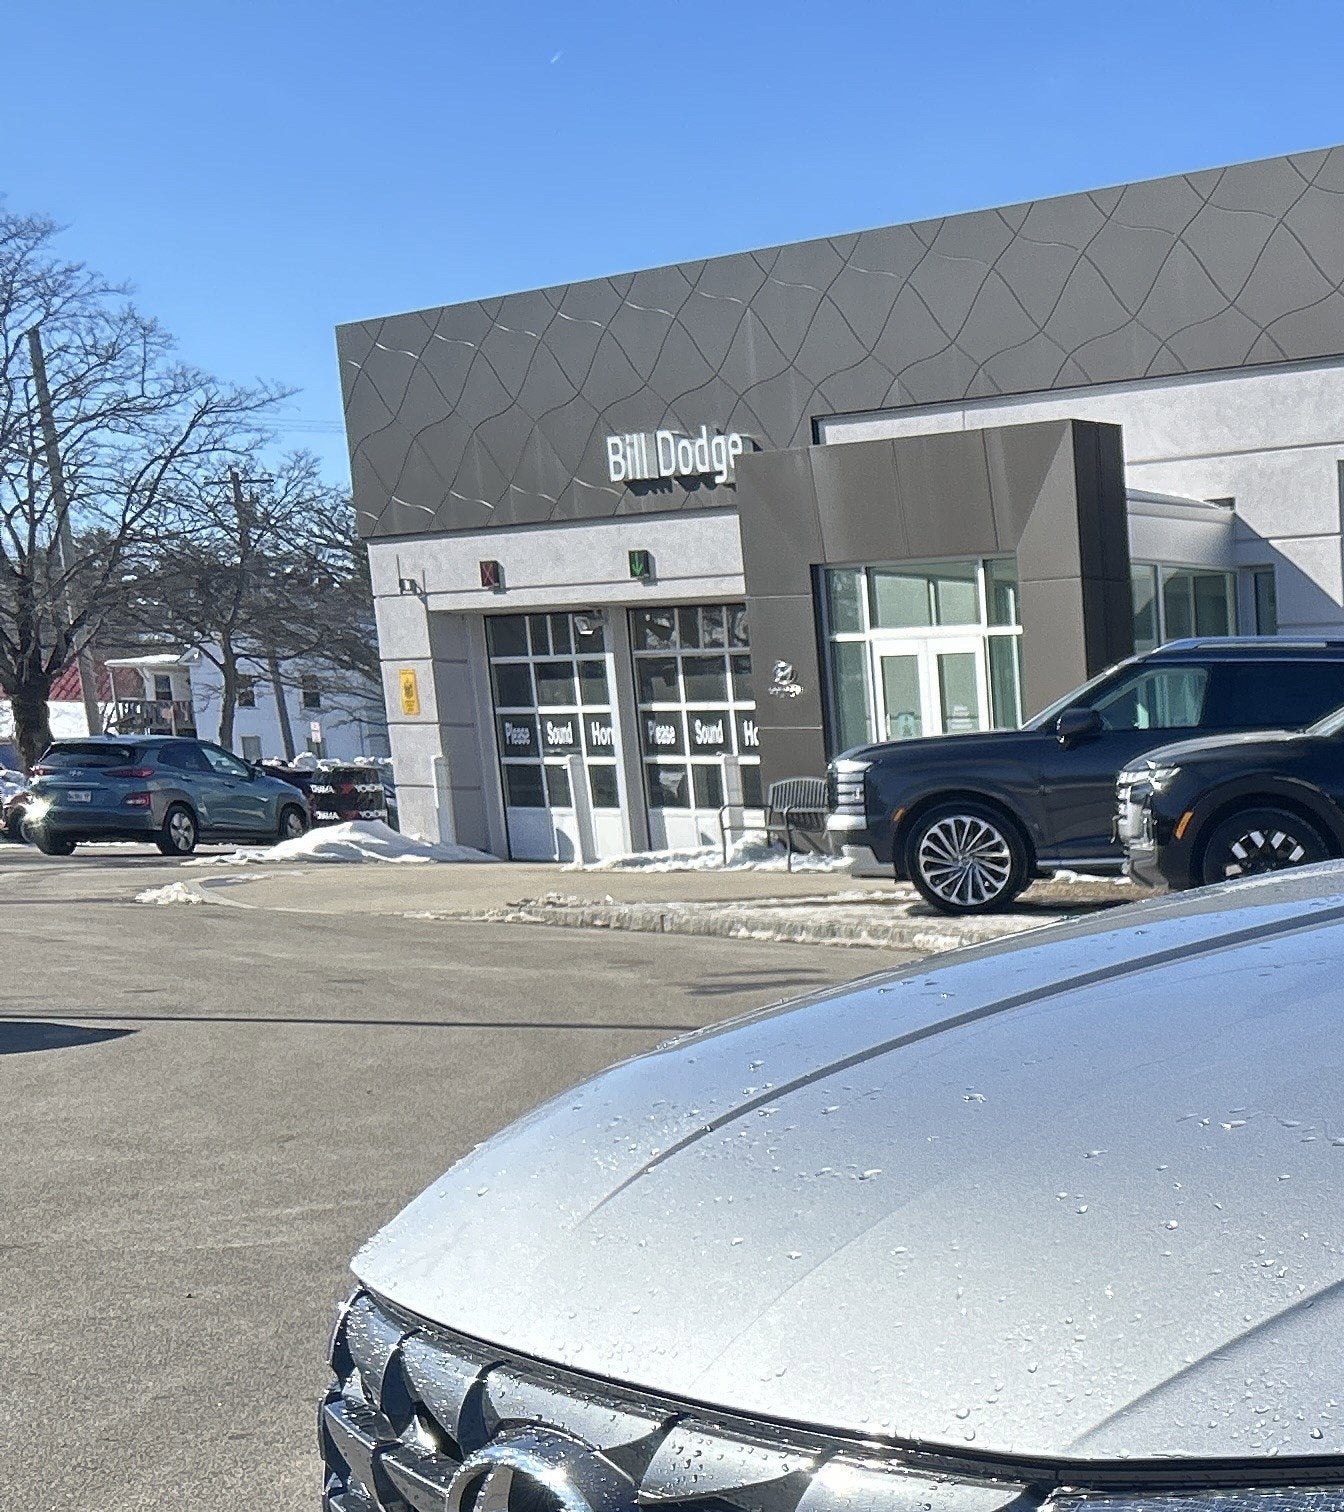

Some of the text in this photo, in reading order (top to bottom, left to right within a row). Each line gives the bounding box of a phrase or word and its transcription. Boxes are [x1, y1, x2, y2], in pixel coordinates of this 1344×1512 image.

[607, 425, 743, 484] Bill Dodge
[505, 721, 531, 745] Please
[546, 721, 574, 745] Sound
[648, 720, 676, 745] Please
[694, 719, 724, 745] Sound
